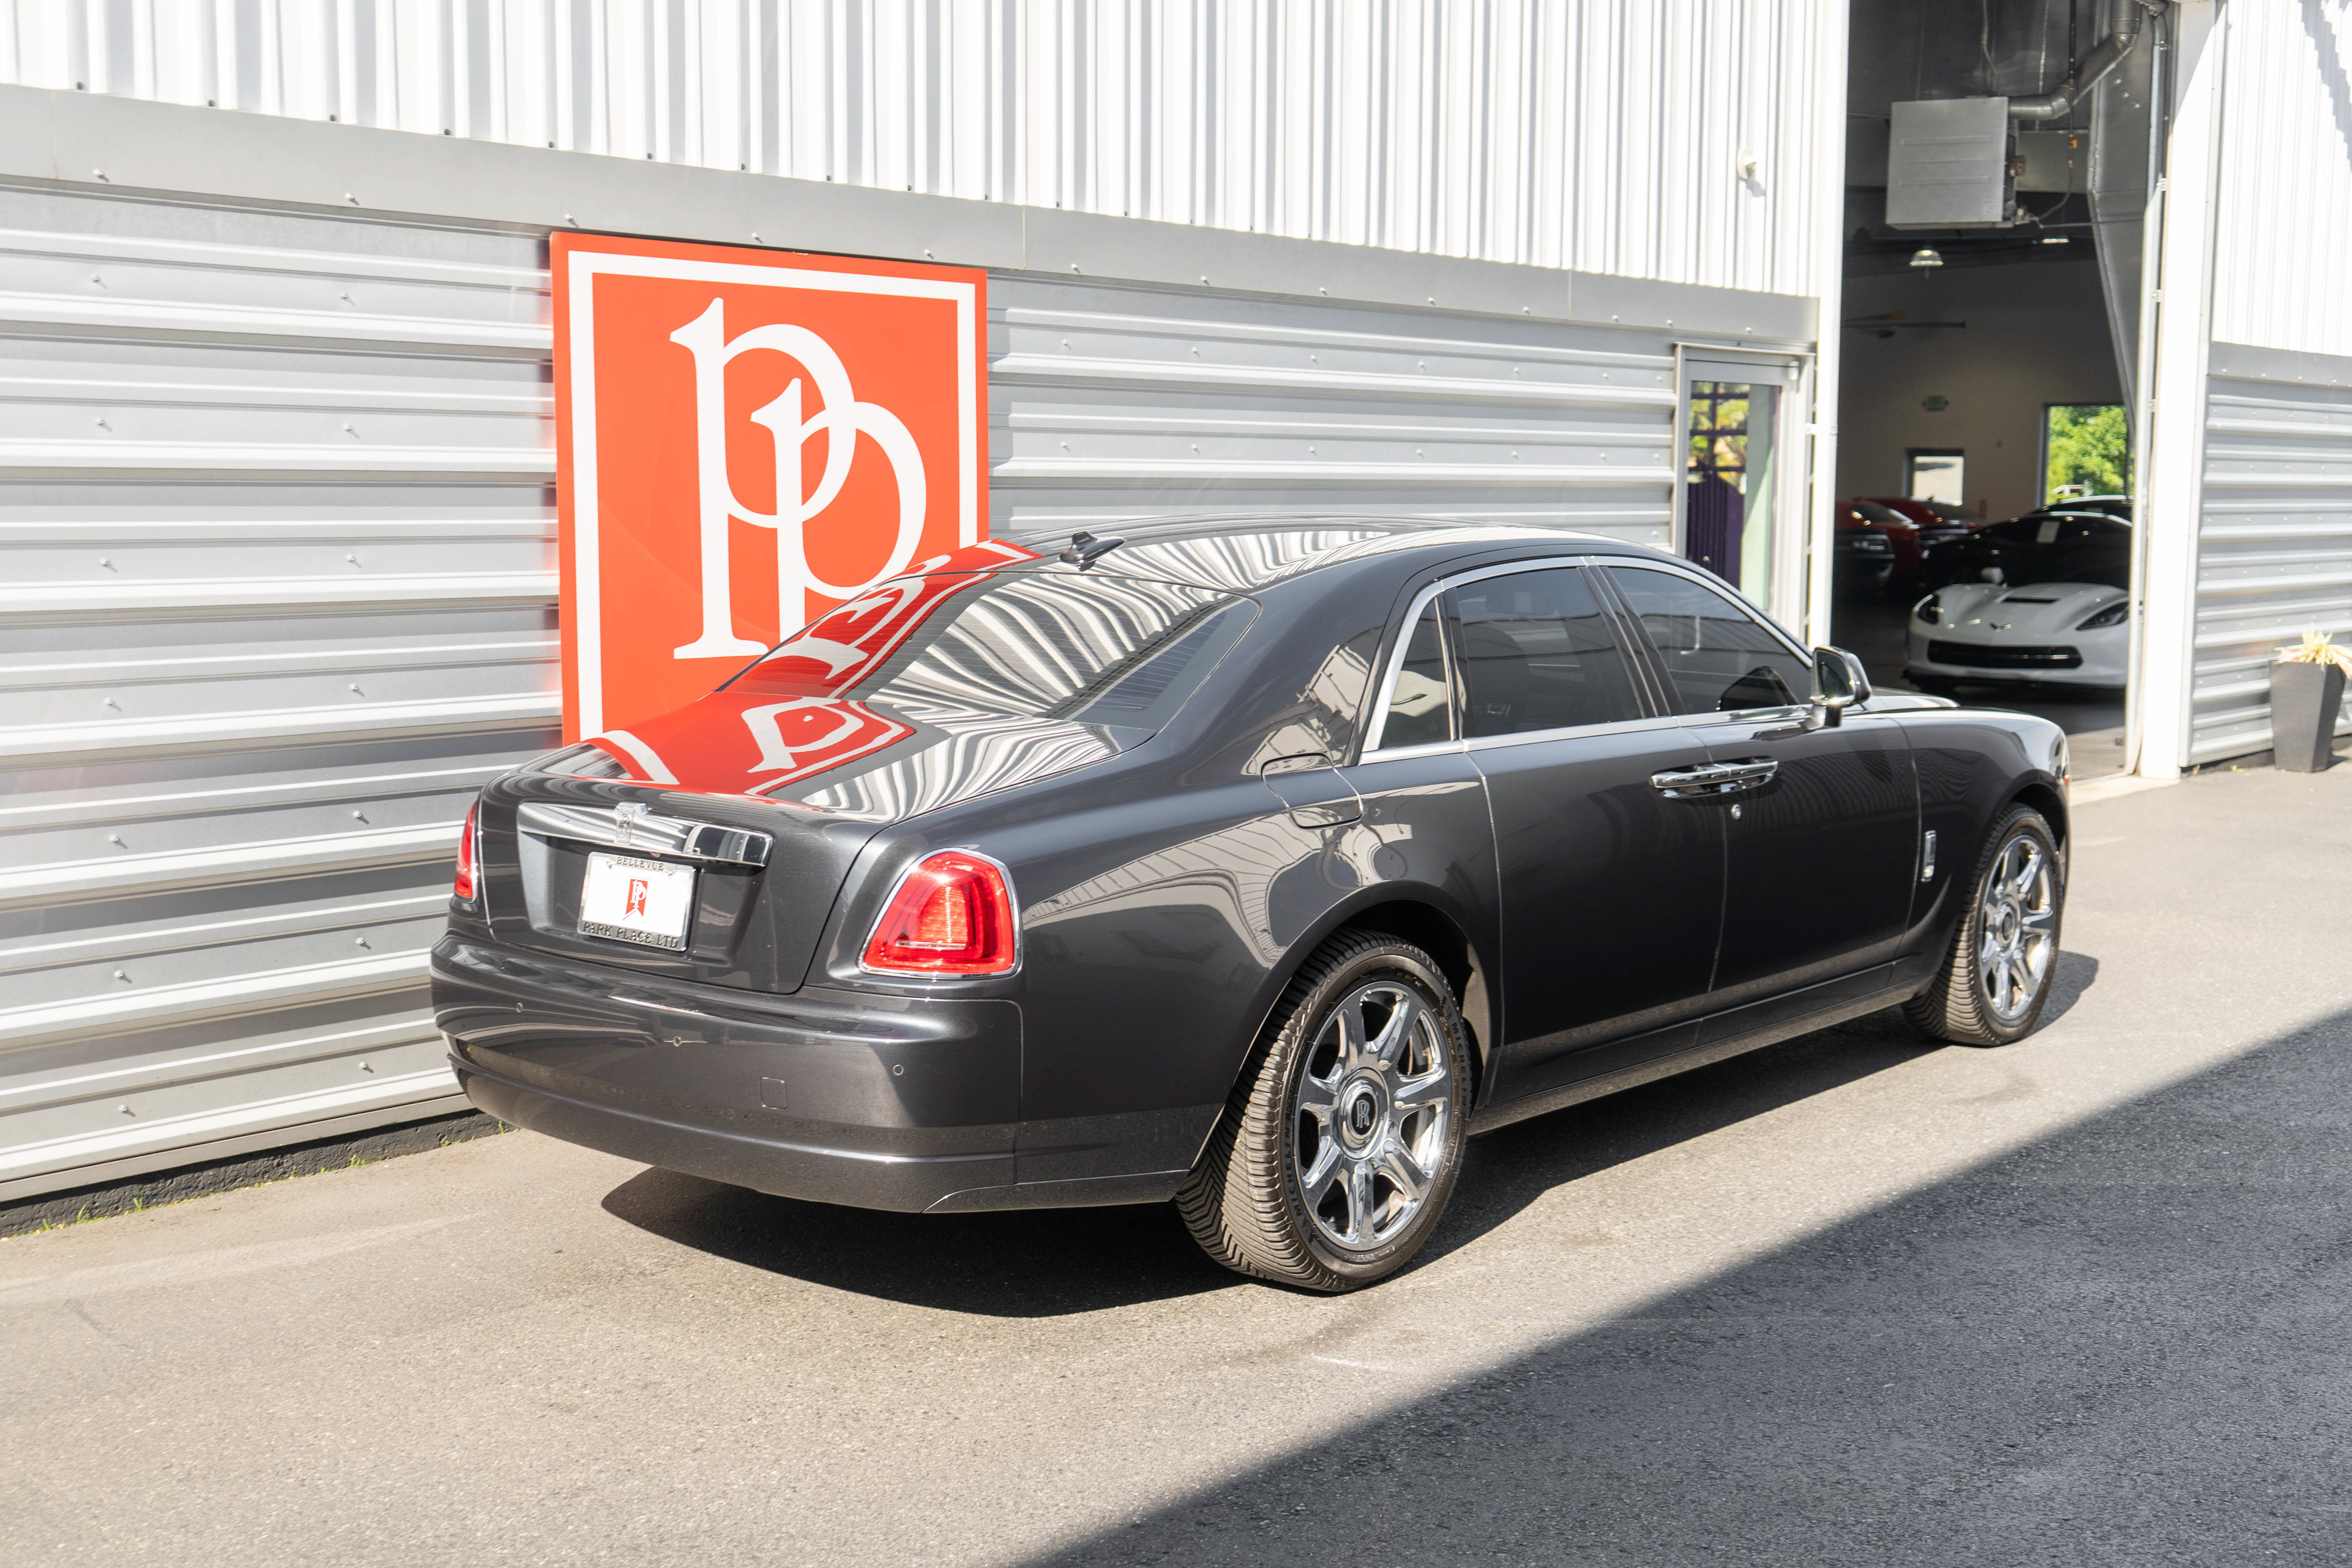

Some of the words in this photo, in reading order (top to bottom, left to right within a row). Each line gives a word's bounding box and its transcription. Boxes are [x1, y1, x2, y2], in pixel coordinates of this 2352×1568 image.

[616, 857, 664, 871] BELLEVUE
[583, 921, 612, 936] PARK
[616, 927, 652, 944] PLACE
[656, 934, 679, 948] LTD
[1451, 1022, 1467, 1106] MICHELIN
[1356, 1099, 1370, 1129] RR
[1284, 1127, 1303, 1217] MICHELIN
